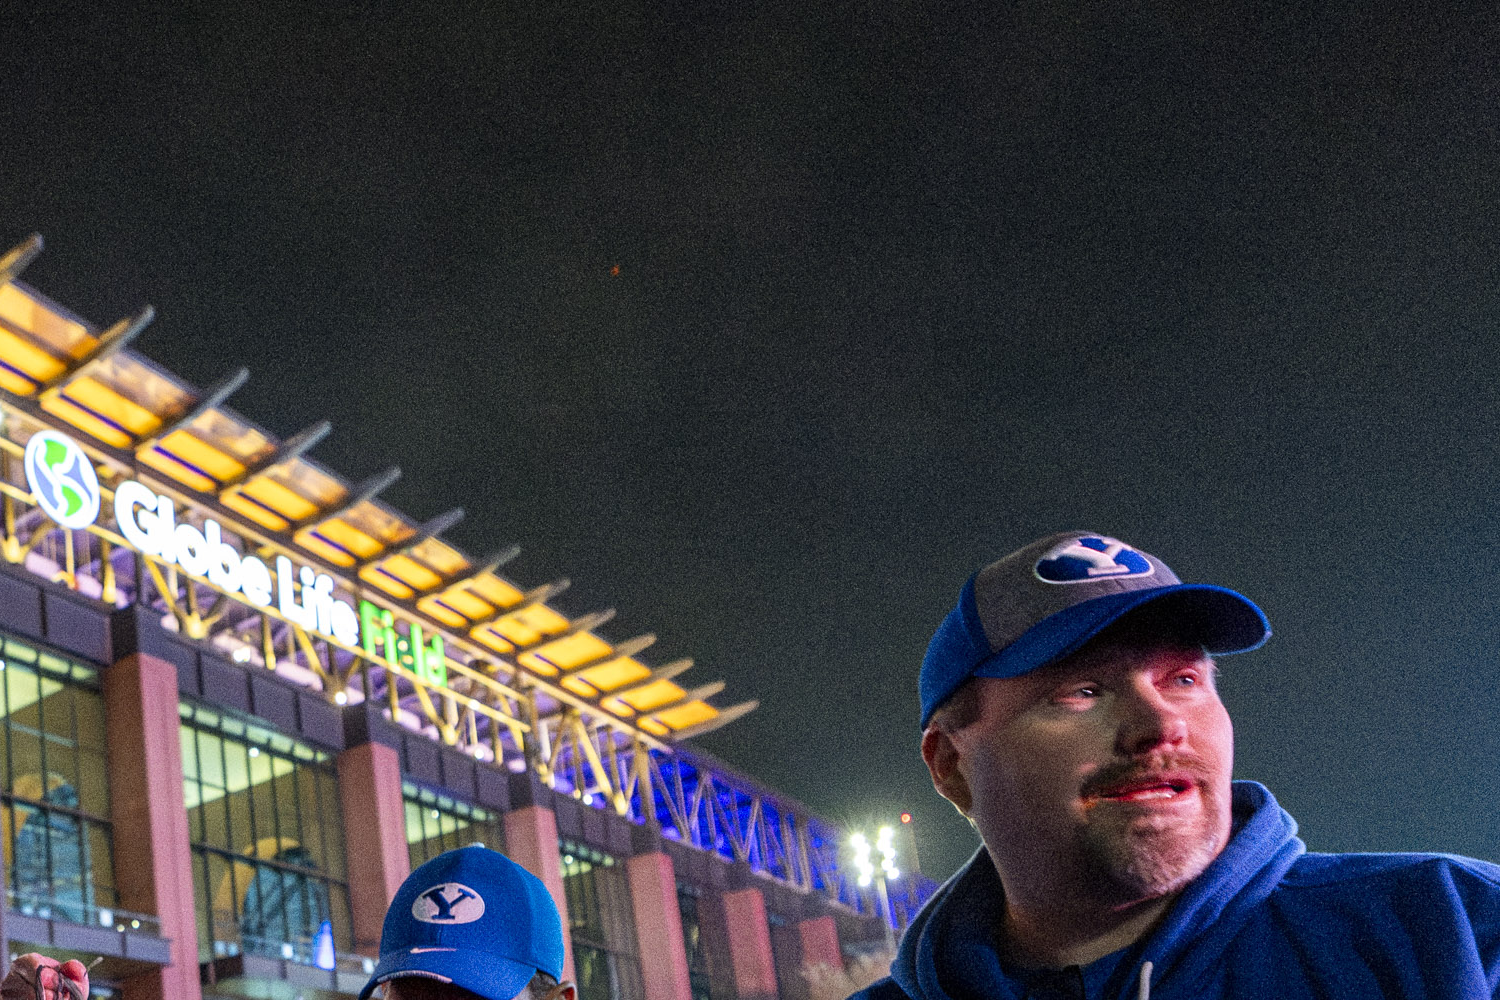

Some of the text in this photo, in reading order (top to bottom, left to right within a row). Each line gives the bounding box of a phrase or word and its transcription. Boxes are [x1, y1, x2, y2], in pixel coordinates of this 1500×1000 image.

[114, 480, 448, 688] Globe Life Field
[422, 886, 476, 920] Y
